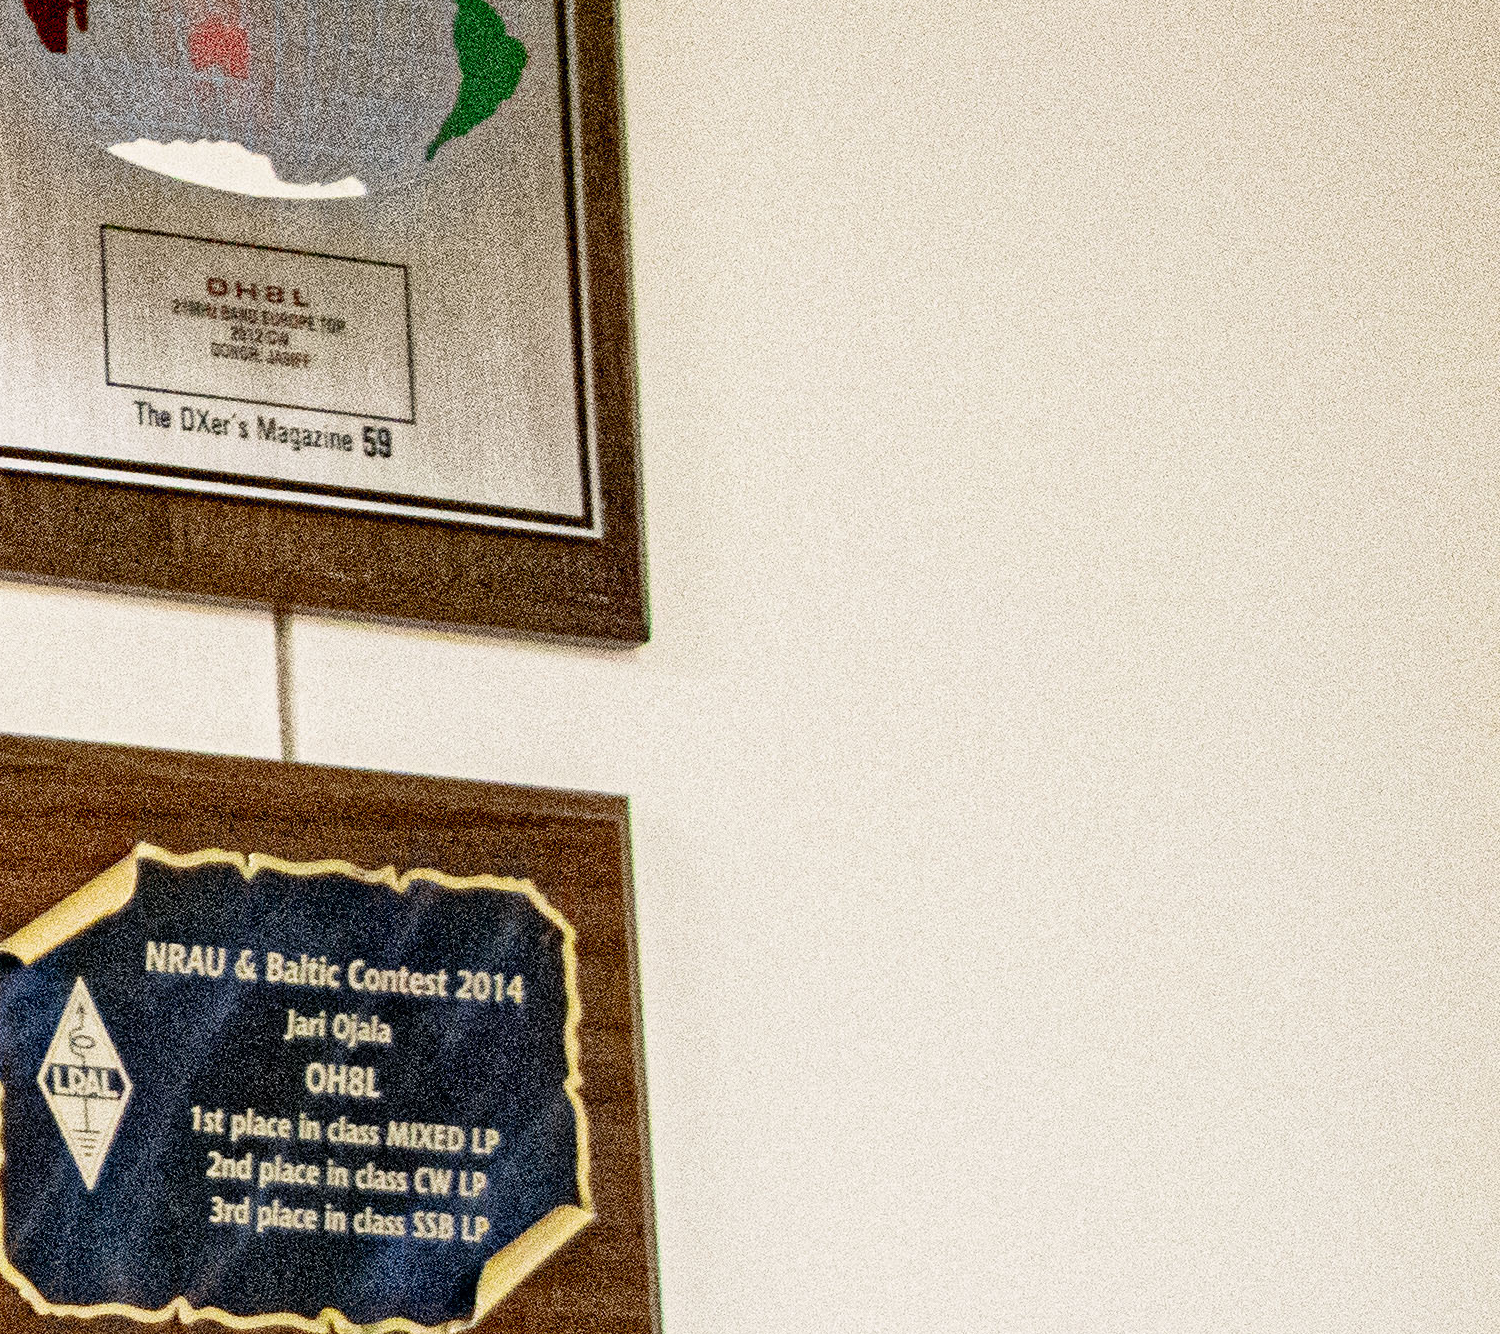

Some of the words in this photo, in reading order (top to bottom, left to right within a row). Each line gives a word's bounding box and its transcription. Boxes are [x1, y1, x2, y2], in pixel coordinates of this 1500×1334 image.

[133, 400, 171, 430] The
[257, 416, 353, 452] Magazine
[363, 425, 393, 458] 59
[145, 940, 226, 980] NRAU
[234, 947, 259, 981] &
[266, 949, 341, 988] Baltic
[347, 958, 449, 999] Contest
[456, 969, 526, 1004] 2014
[282, 1008, 326, 1043] Jari
[332, 1011, 393, 1047] Ojala
[304, 1062, 382, 1099] OH8L
[191, 1105, 225, 1135] 1st
[231, 1107, 292, 1142] place
[299, 1112, 321, 1139] in
[327, 1115, 380, 1146] class
[385, 1120, 465, 1151] MIXED
[472, 1127, 500, 1156] LP
[206, 1151, 252, 1179] 2nd
[258, 1155, 321, 1188] place
[327, 1159, 349, 1186] in
[354, 1161, 408, 1193] class
[414, 1166, 452, 1196] CW
[459, 1169, 488, 1197] LP
[209, 1197, 250, 1224] 3rd
[256, 1199, 317, 1232] place
[324, 1203, 346, 1230] in
[352, 1206, 406, 1237] class
[412, 1210, 454, 1240] SSB
[462, 1213, 490, 1242] LP
